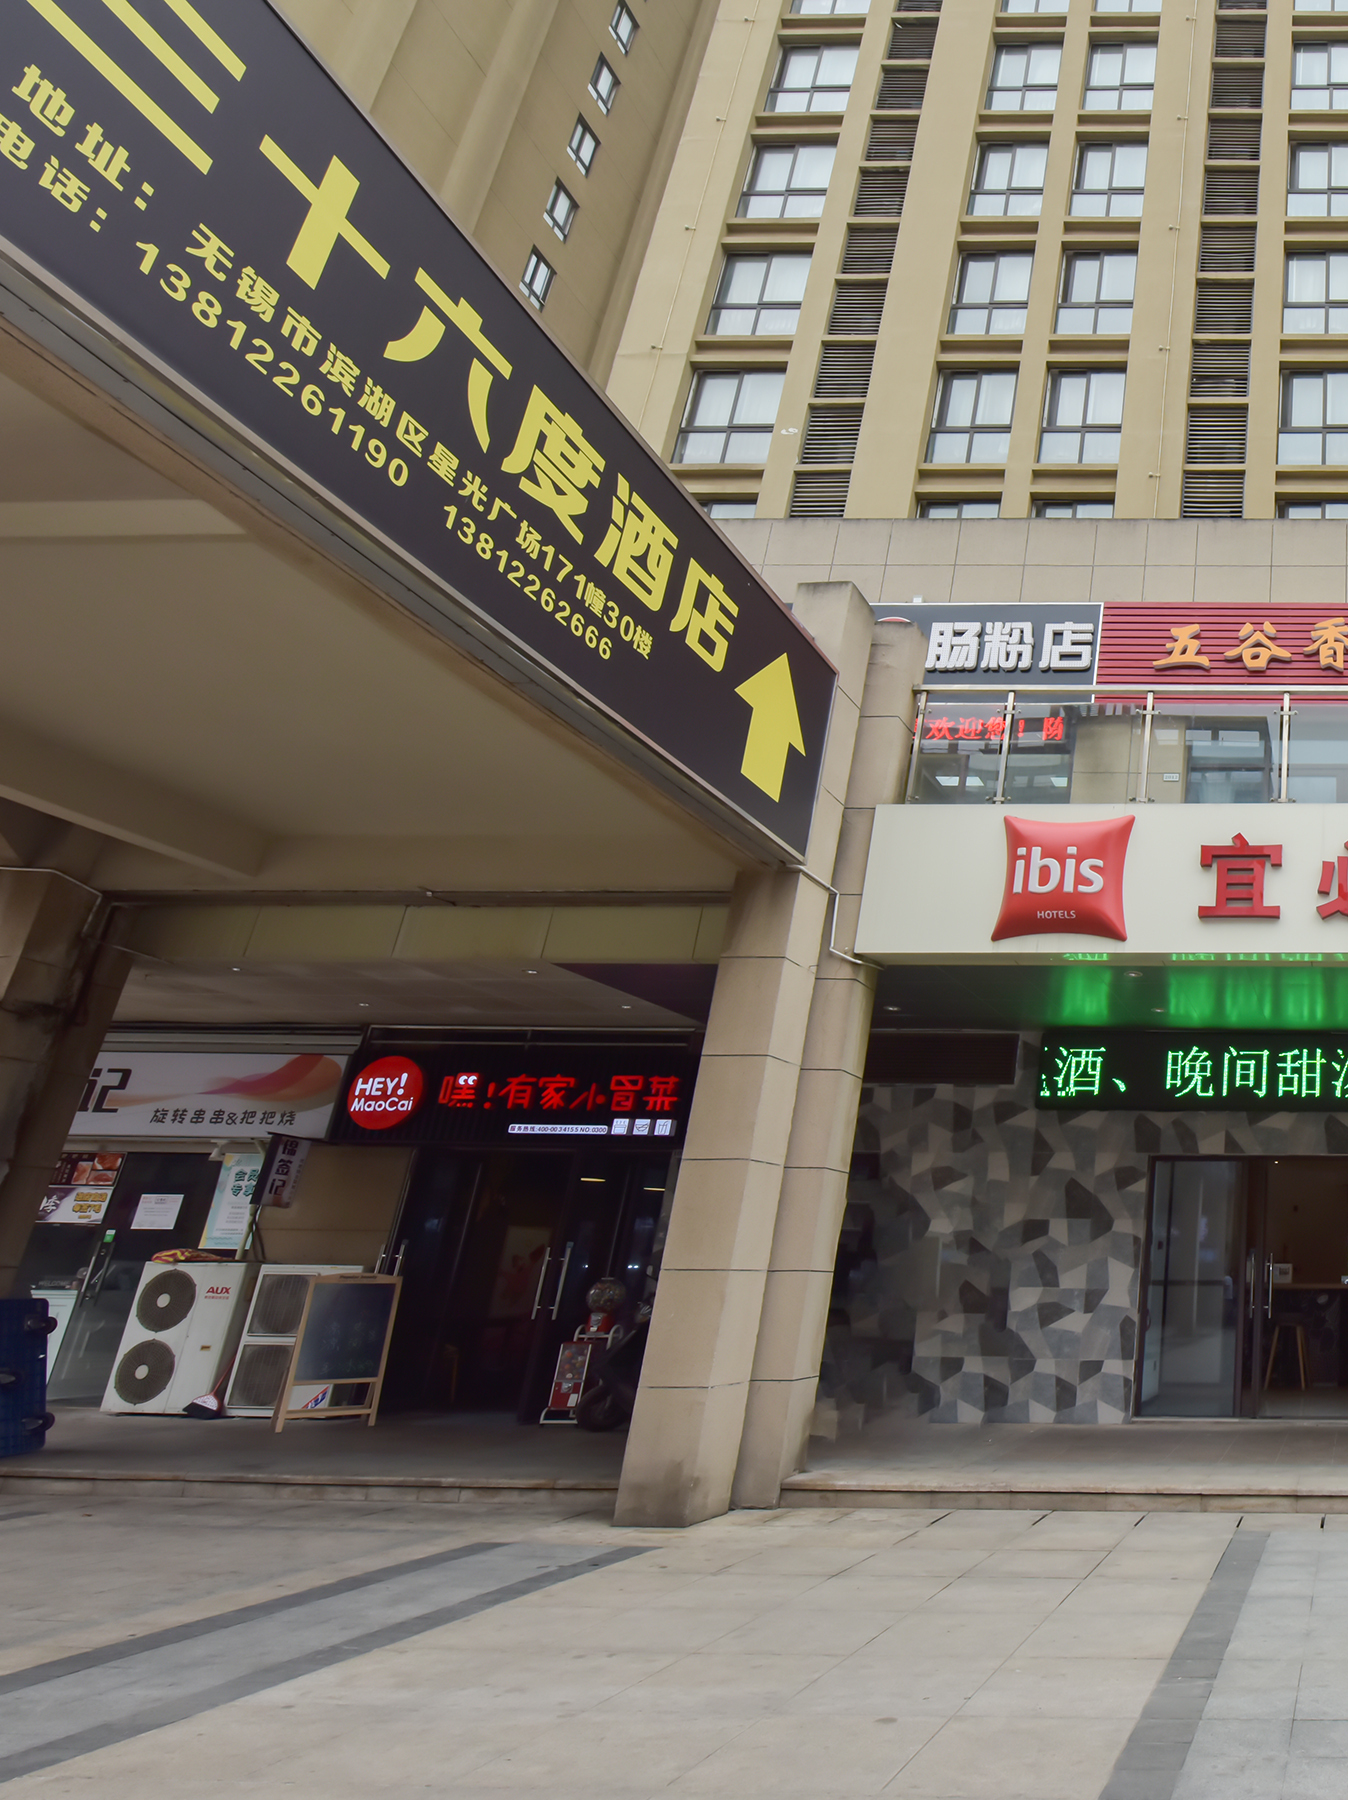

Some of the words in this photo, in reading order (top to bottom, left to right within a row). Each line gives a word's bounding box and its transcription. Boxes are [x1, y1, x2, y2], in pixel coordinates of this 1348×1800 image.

[136, 242, 409, 487] 13812261190
[444, 506, 612, 660] 13812262666
[925, 621, 1095, 672] 肠粉店
[1012, 846, 1104, 894] ibis
[1037, 910, 1077, 919] HOTELS
[354, 1072, 408, 1097] HEY!
[350, 1096, 413, 1112] MaoCai
[150, 1108, 297, 1126] 旋转串串&把把烧
[206, 1286, 232, 1295] AUX
